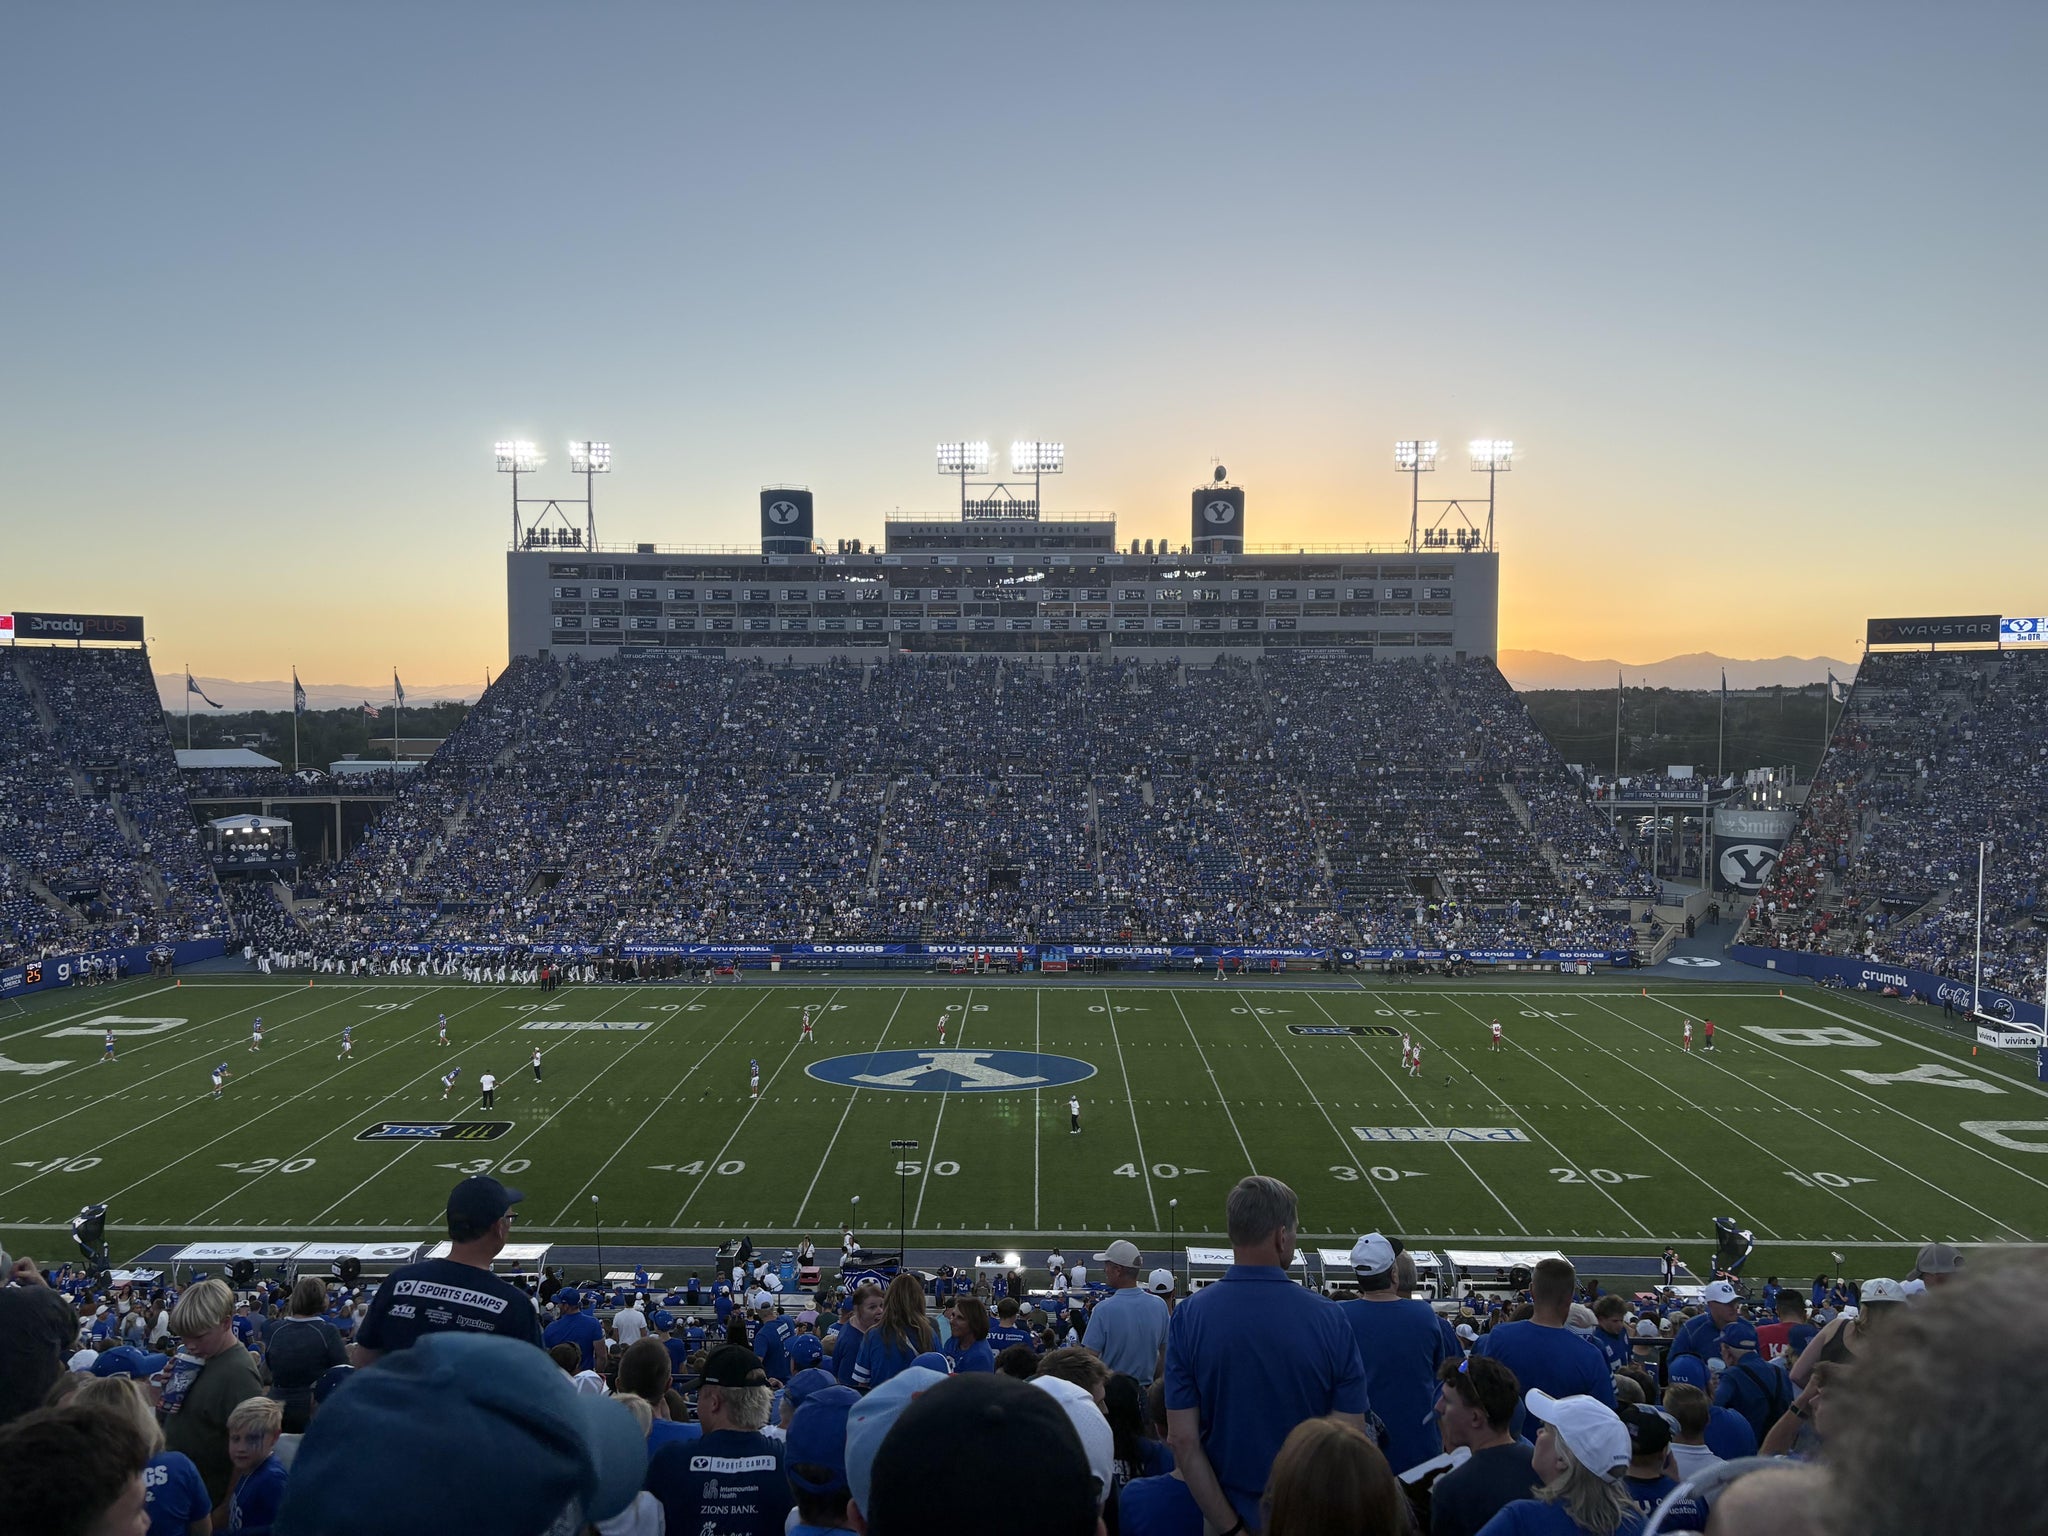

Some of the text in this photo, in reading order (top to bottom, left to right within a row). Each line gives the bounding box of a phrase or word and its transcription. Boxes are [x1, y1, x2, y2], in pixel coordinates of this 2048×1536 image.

[910, 526, 1091, 534] LAVELL EDWARDS STADIUM
[1898, 624, 1991, 635] WAYSTAR
[1738, 815, 1790, 834] Smith's
[813, 945, 884, 953] GO COUGS
[1073, 946, 1172, 955] BYU COUGARS
[1560, 961, 1592, 974] COUGS
[2, 973, 23, 983] MOUNTAIN
[3, 979, 21, 988] AMERICA
[26, 969, 41, 984] 25
[1861, 970, 1908, 987] crumbl
[1937, 982, 1972, 1007] Coca-Cola
[517, 1003, 566, 1011] 20
[654, 1003, 707, 1011] 30
[38, 1157, 103, 1172] 10
[236, 1157, 317, 1173] 20
[459, 1158, 532, 1174] 30
[676, 1160, 746, 1176] 40
[895, 1160, 961, 1177] 50
[1113, 1162, 1179, 1179] 40
[1328, 1165, 1400, 1182] 30
[1548, 1168, 1624, 1184] 20
[1782, 1171, 1850, 1188] 10
[201, 1247, 242, 1255] PACS
[418, 1284, 462, 1300] SPORTS
[462, 1292, 503, 1311] CAMPS
[986, 1332, 1004, 1340] BYU
[716, 1461, 742, 1470] SPORTS
[745, 1459, 771, 1468] CAMPS
[143, 1465, 168, 1486] GS
[720, 1485, 759, 1493] Intermountain
[700, 1505, 729, 1514] ZIONS
